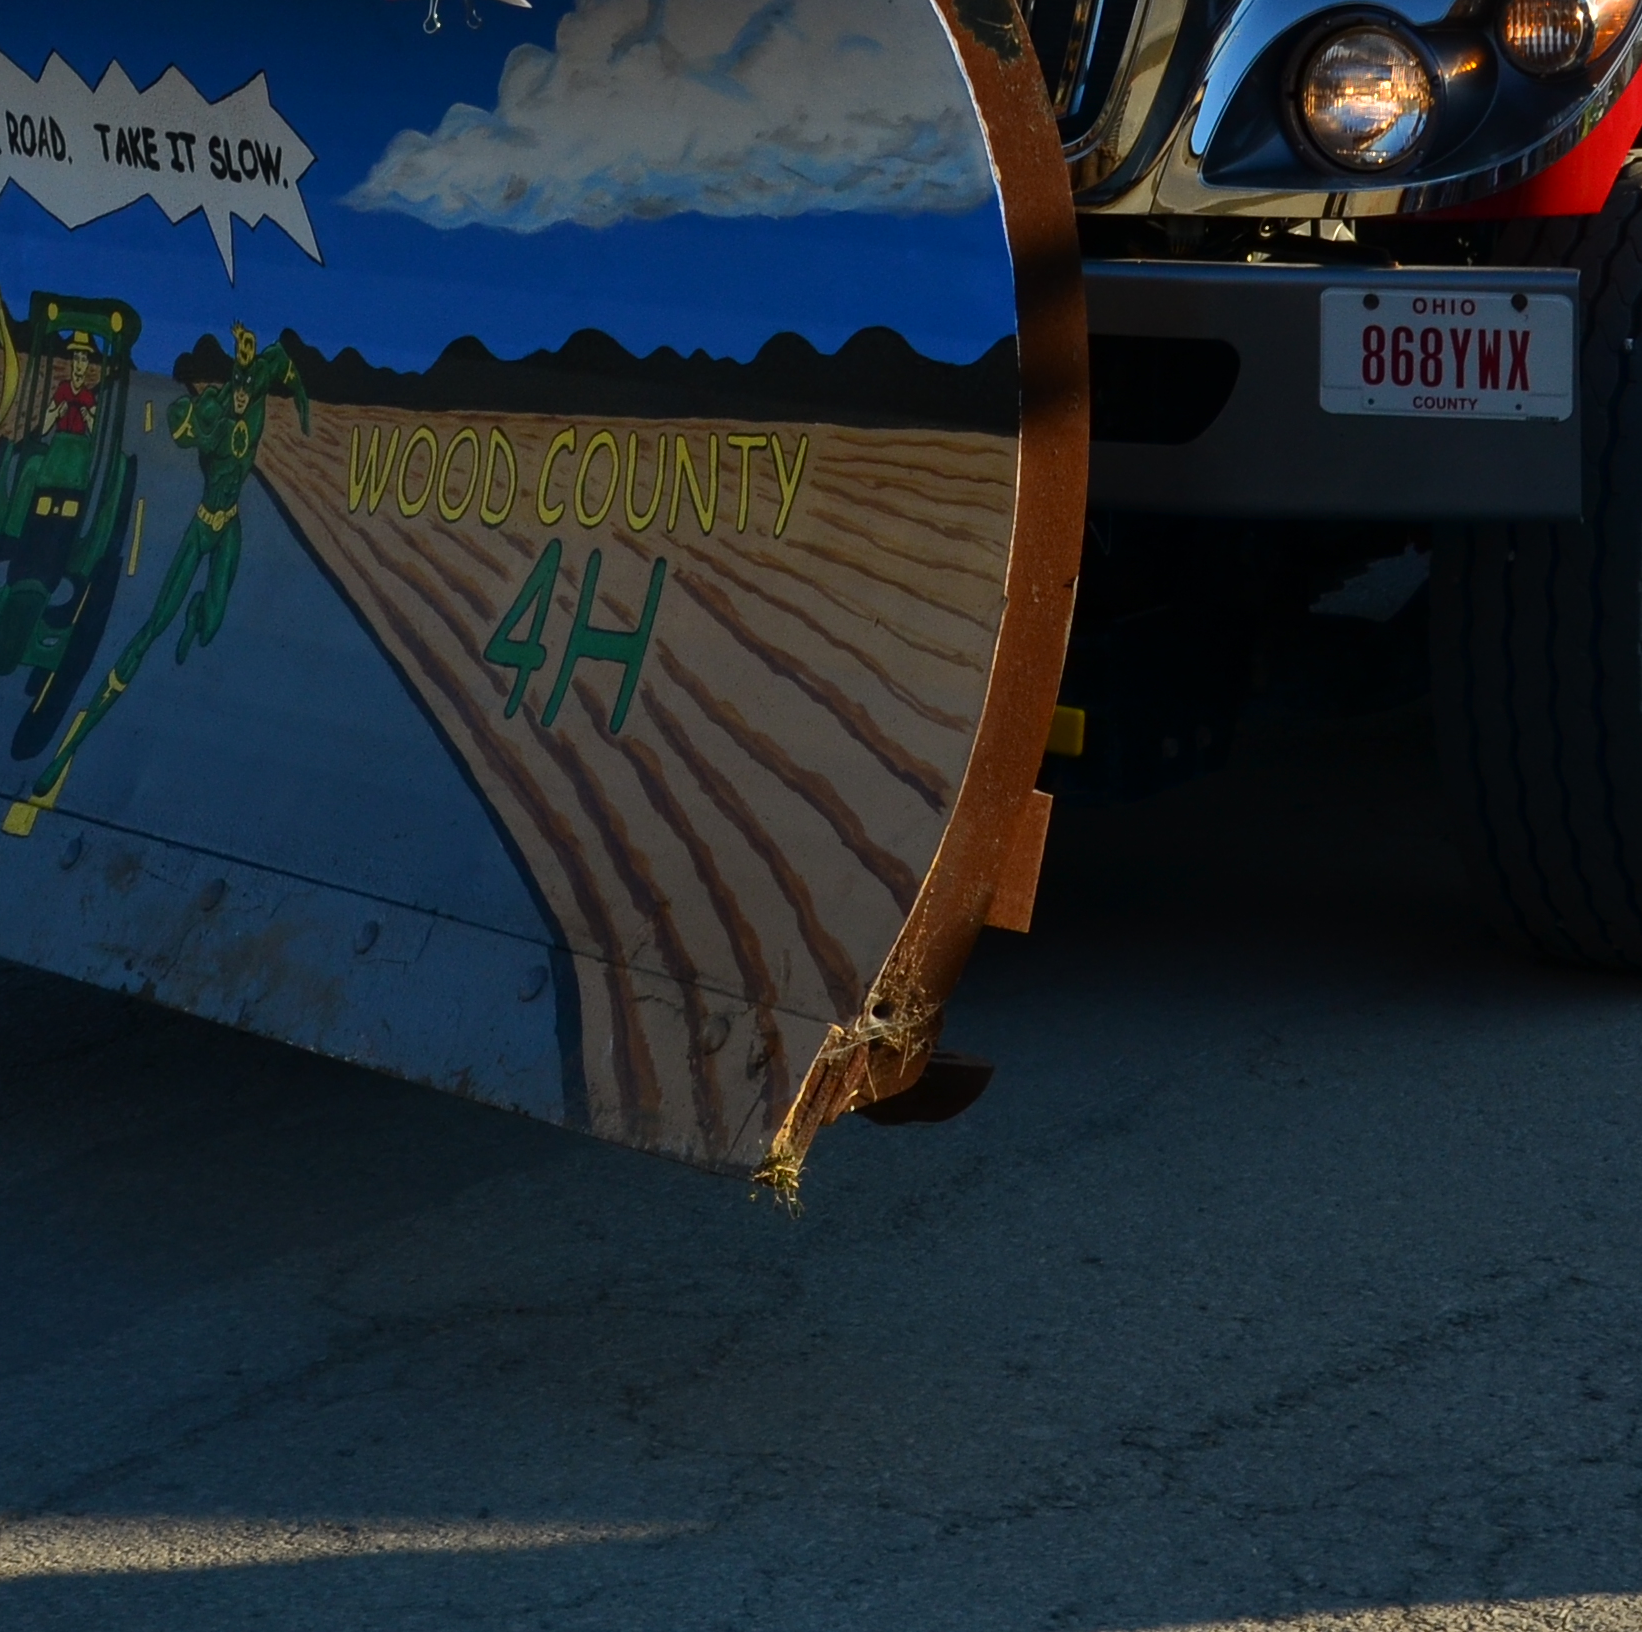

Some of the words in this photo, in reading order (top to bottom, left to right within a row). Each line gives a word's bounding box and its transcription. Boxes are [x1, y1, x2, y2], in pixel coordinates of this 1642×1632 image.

[5, 109, 73, 165] ROAD.
[93, 122, 161, 172] TAKE
[165, 130, 197, 173] IT
[207, 134, 289, 190] SLOW.
[1412, 296, 1477, 316] OHIO
[1361, 324, 1531, 392] 868YWX
[1412, 395, 1479, 411] COUNTY
[347, 424, 518, 529] WOOD
[535, 424, 809, 539] COUNTY
[483, 537, 668, 735] 4H
